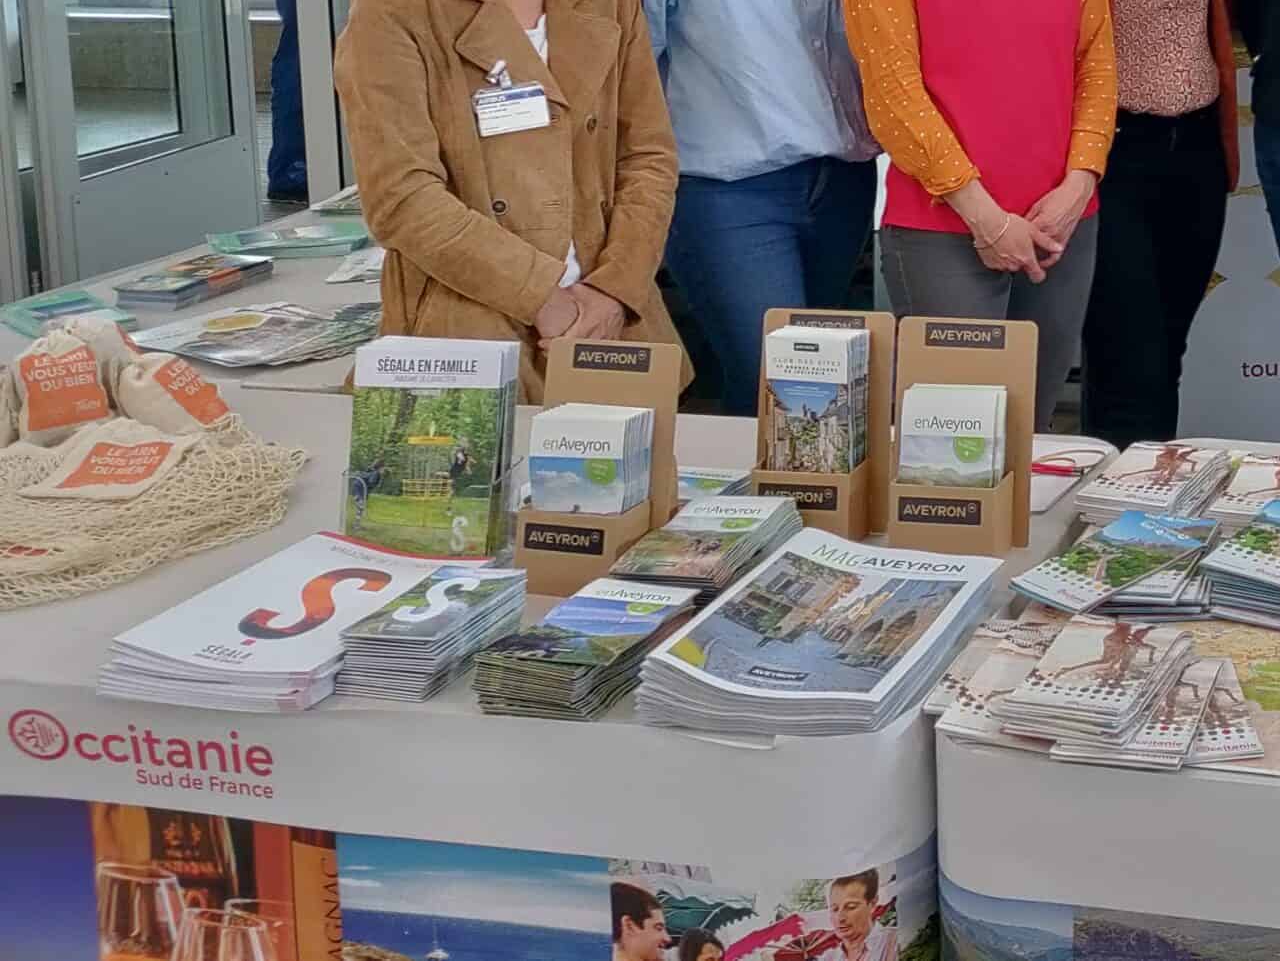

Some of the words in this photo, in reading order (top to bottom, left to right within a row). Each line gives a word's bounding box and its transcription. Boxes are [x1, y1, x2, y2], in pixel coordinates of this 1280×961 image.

[930, 329, 992, 342] AVEYRON
[418, 359, 431, 372] EN
[434, 359, 478, 373] FAMILLE
[577, 351, 638, 365] AVEYRON
[914, 416, 982, 433] enAveyron
[543, 437, 610, 454] enAveyron
[902, 504, 967, 518] AVEYRON
[528, 530, 592, 547] AVEYRON
[8, 709, 274, 776] Occitanie
[136, 769, 173, 788] Sud
[179, 773, 203, 790] de
[209, 776, 274, 799] France
